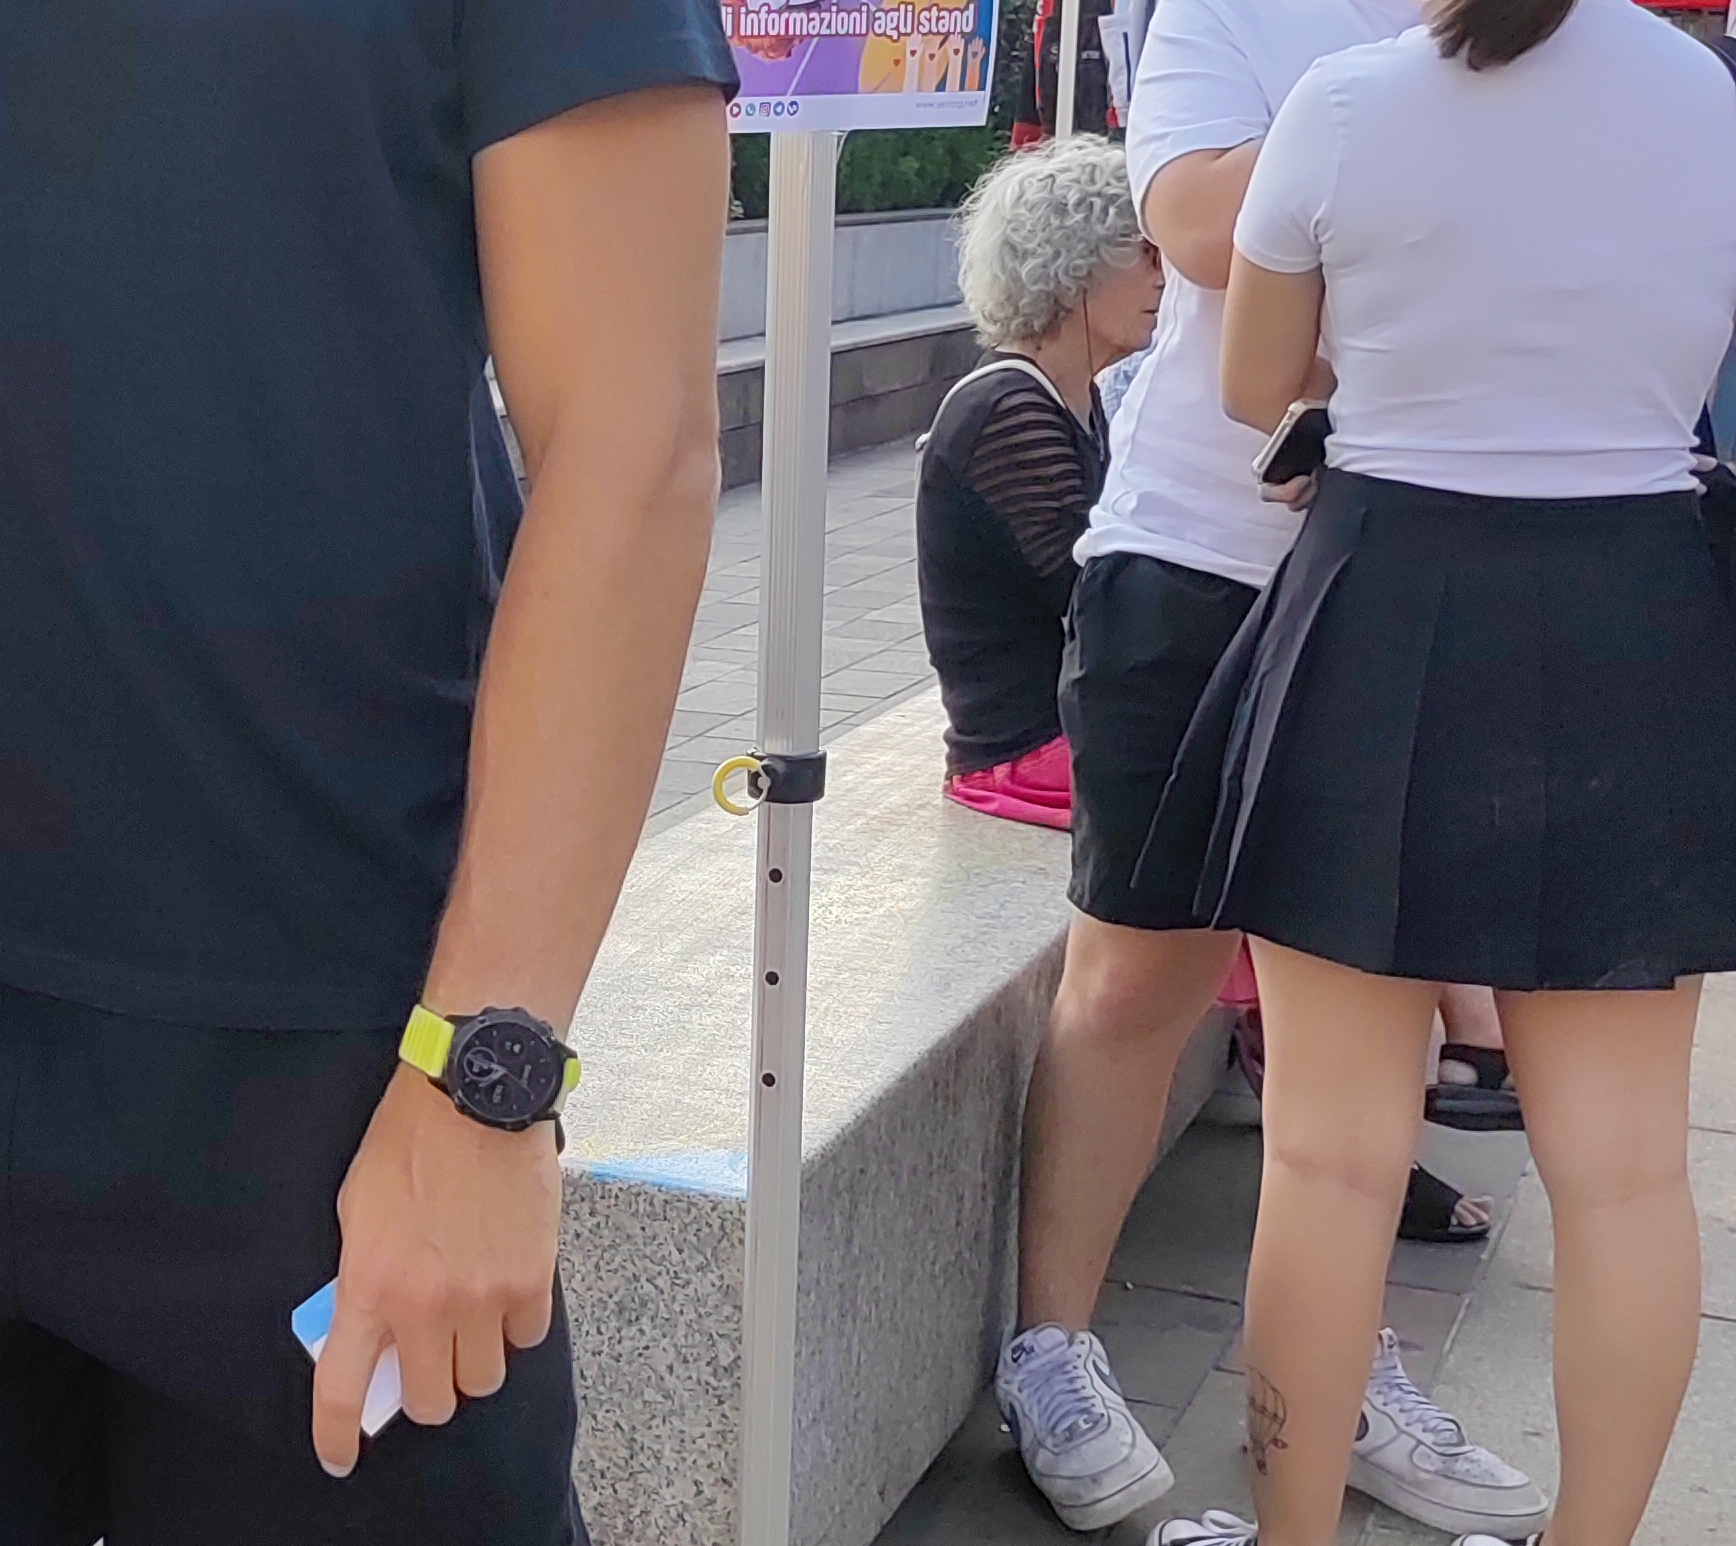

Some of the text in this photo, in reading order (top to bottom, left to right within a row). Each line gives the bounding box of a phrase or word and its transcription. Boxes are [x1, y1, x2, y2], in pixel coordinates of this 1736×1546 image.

[740, 4, 867, 36] informazioni
[873, 3, 913, 40] agli
[919, 3, 975, 34] stand
